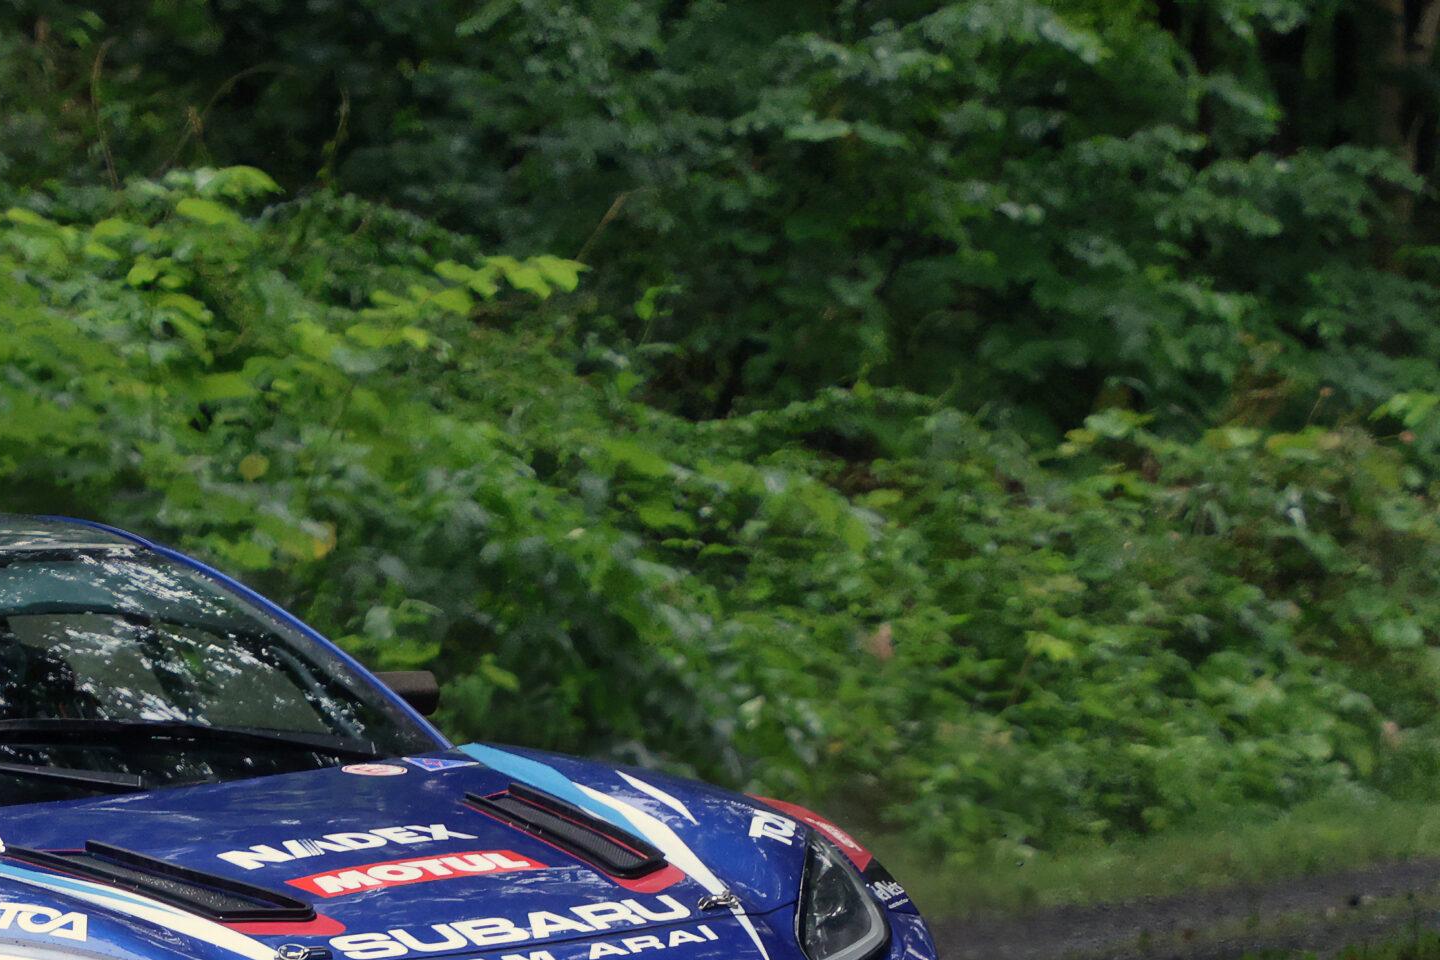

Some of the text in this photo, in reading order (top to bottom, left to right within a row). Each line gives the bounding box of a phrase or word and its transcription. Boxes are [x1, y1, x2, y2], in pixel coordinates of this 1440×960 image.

[217, 823, 479, 870] NADEX
[312, 852, 531, 894] MOTUL
[328, 894, 692, 960] SUBARU
[589, 924, 719, 960] ARAI
